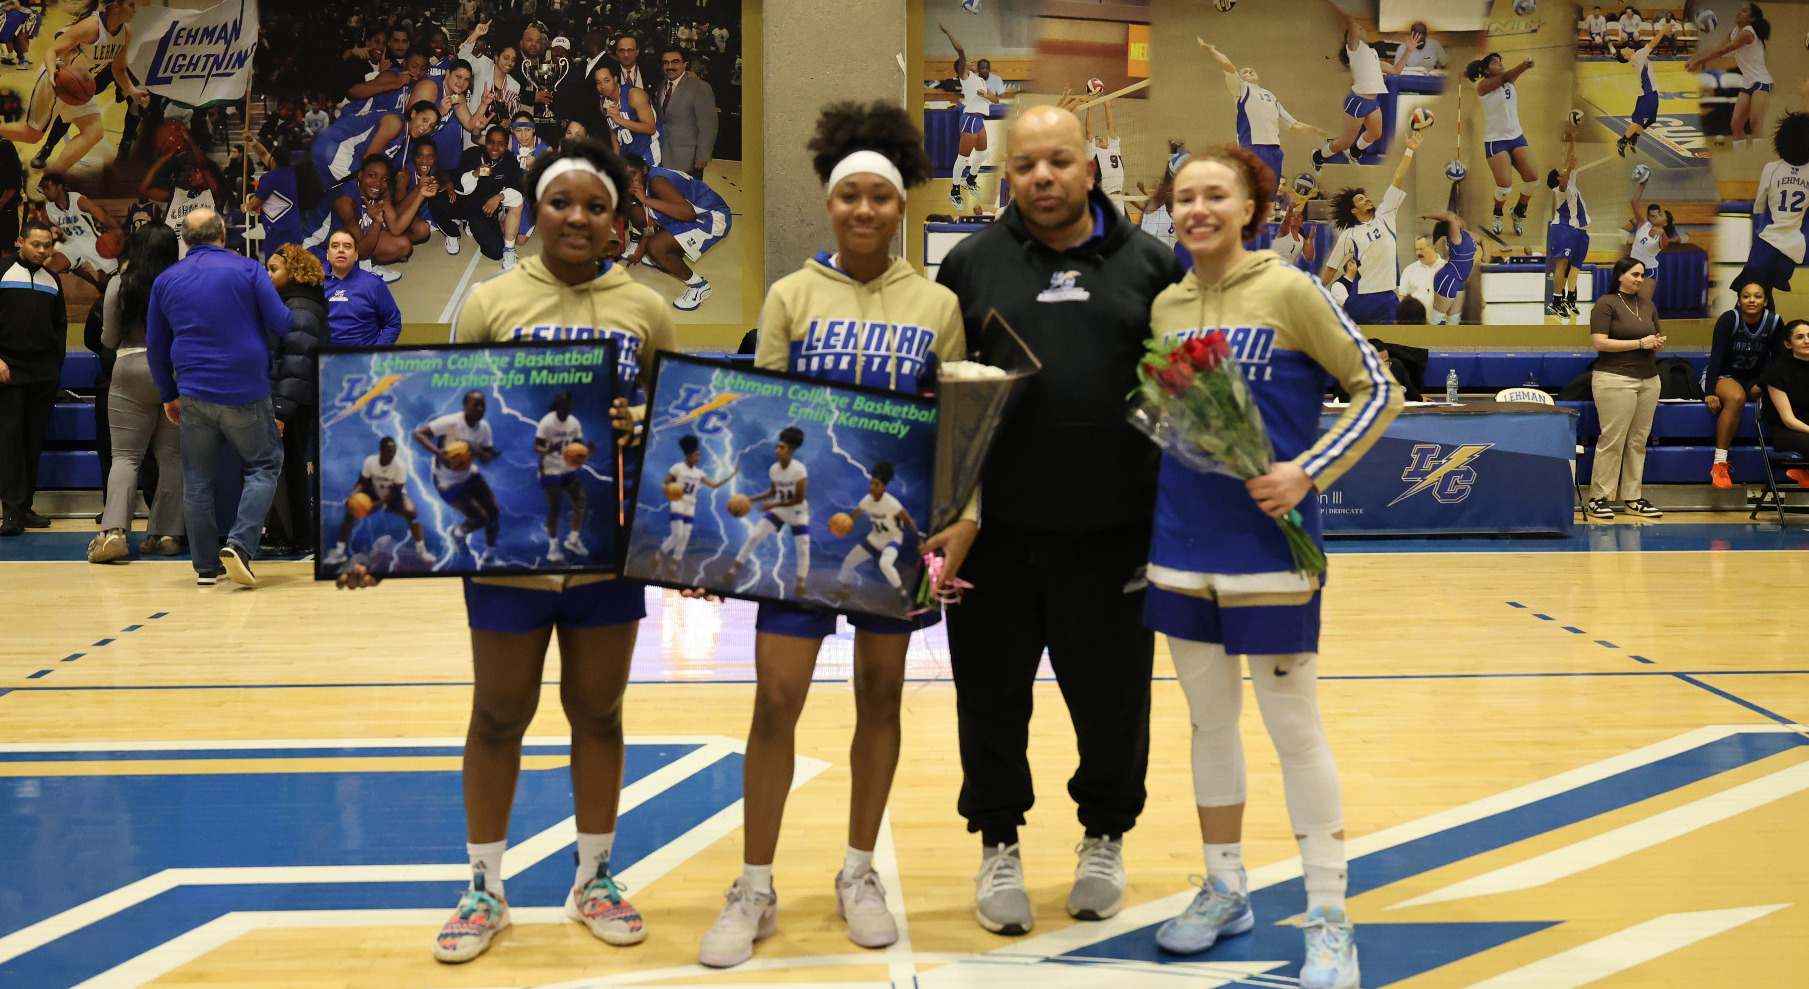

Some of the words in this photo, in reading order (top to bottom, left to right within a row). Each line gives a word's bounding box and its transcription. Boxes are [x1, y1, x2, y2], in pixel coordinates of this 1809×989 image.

[1258, 92, 1272, 102] 13
[1505, 88, 1511, 100] 9
[1109, 154, 1119, 169] 9
[1777, 189, 1806, 213] 12
[1366, 227, 1382, 243] 12
[375, 353, 442, 373] Lehman
[447, 352, 510, 372] College
[514, 347, 605, 368] Basketball
[431, 370, 526, 389] Musharafa
[529, 368, 593, 386] Muniru
[715, 371, 784, 397] Lehman
[787, 384, 850, 410] College
[1504, 391, 1546, 404] LEHMAN
[787, 402, 833, 427] Emily
[838, 411, 912, 438] Kennedy
